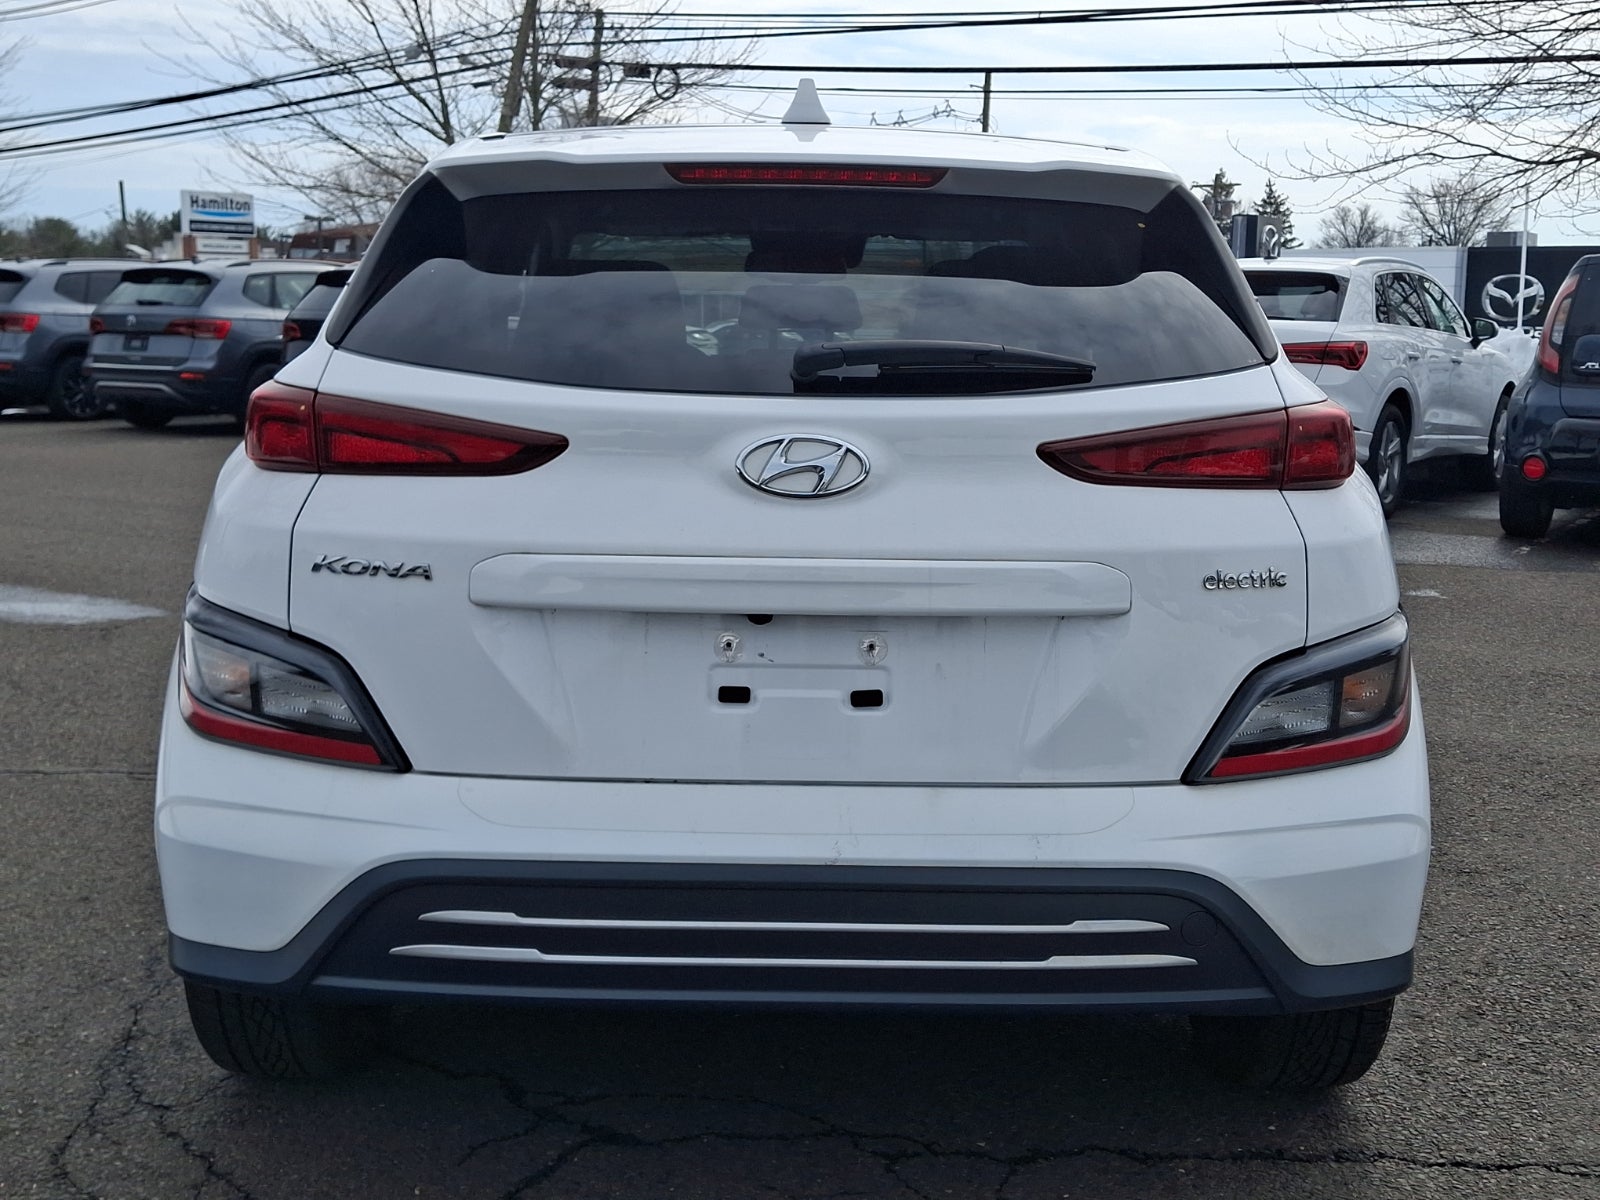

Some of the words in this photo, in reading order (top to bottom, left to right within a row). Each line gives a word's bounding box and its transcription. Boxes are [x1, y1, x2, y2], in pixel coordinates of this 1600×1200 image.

[190, 194, 250, 211] Hamilton
[311, 554, 433, 581] KONA
[1203, 566, 1287, 590] electric
